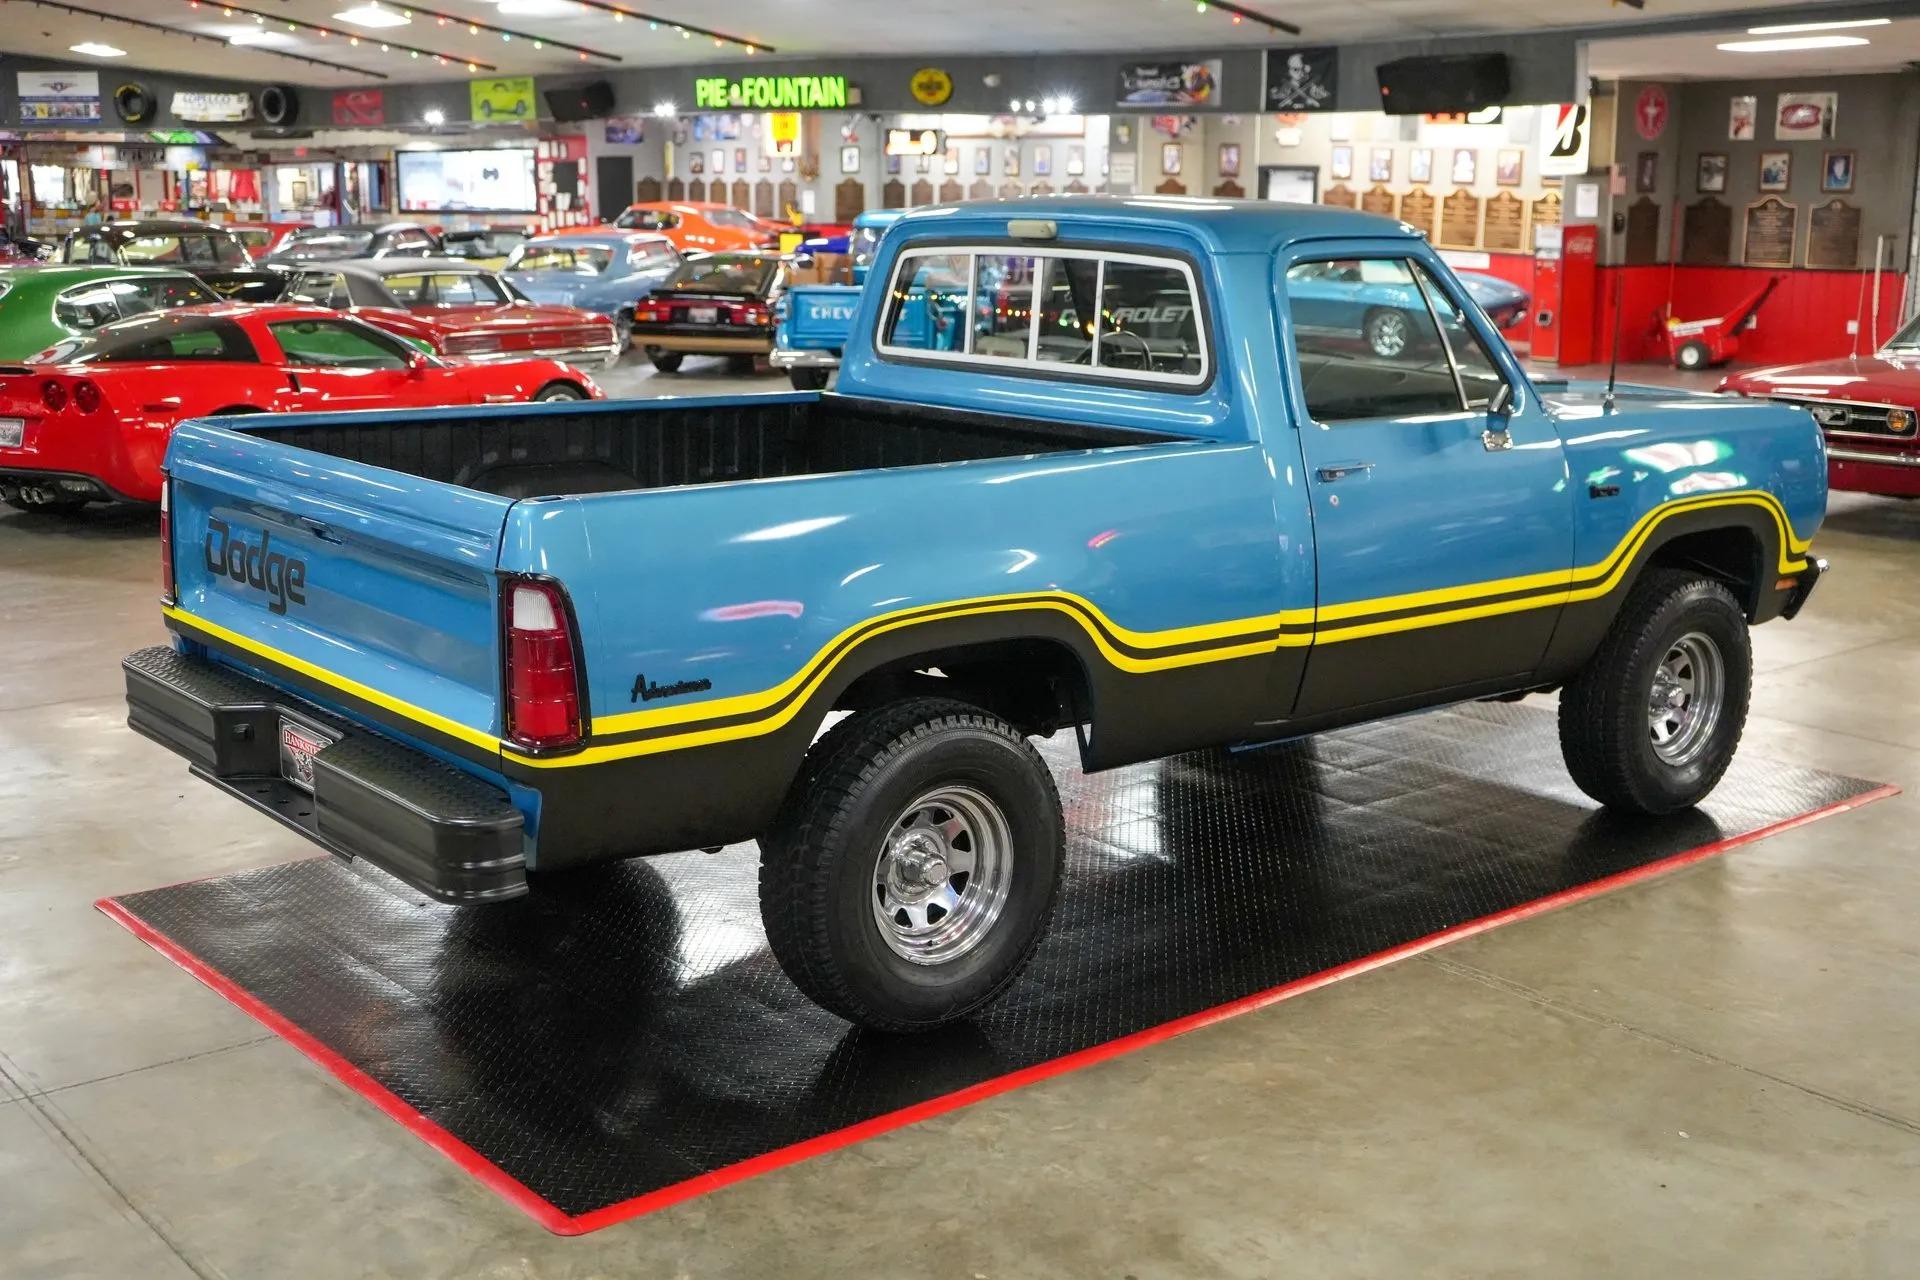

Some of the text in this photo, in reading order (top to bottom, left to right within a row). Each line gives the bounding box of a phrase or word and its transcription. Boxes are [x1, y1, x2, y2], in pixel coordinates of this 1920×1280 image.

[696, 76, 846, 107] PIE FOUNTAIN
[206, 518, 306, 616] Dodge
